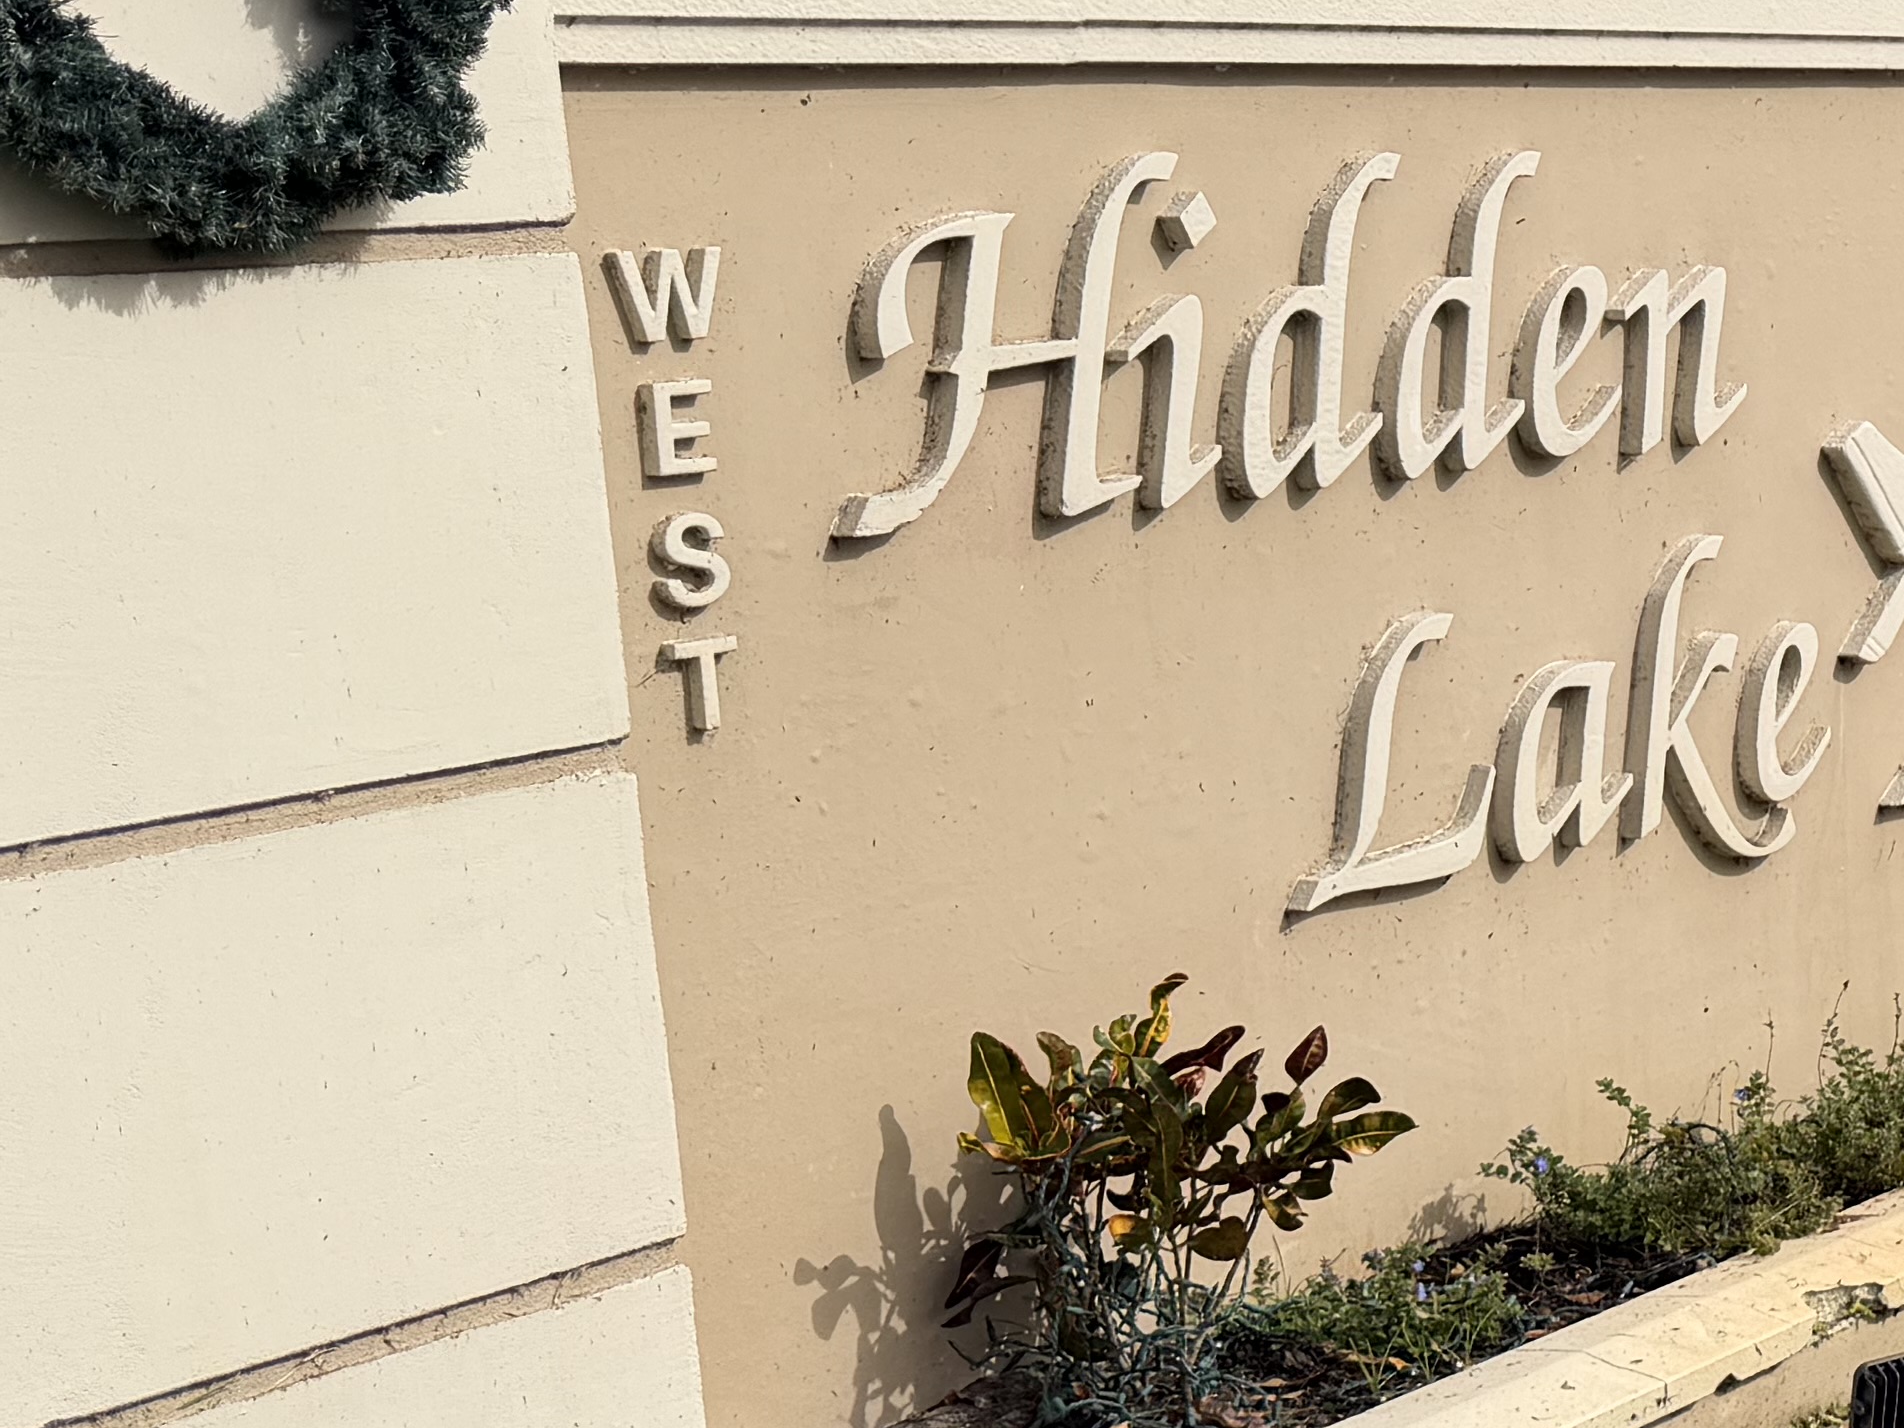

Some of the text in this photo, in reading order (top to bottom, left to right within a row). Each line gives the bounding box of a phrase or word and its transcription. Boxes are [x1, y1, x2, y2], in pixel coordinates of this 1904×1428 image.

[600, 245, 738, 734] WEST
[828, 151, 1749, 539] Hidden
[1286, 534, 1832, 914] Lake
